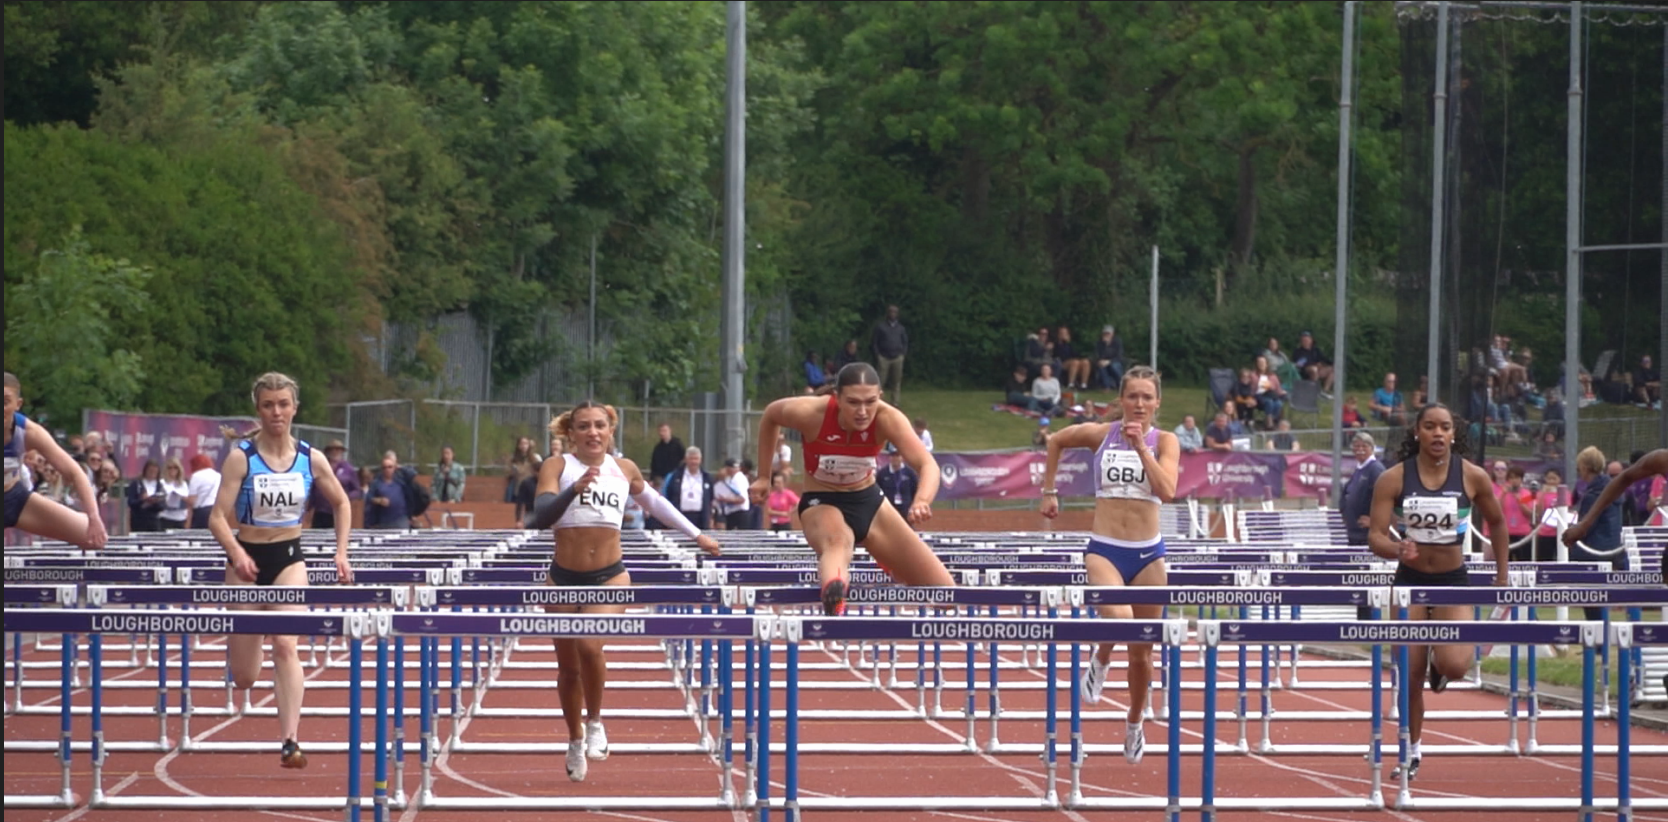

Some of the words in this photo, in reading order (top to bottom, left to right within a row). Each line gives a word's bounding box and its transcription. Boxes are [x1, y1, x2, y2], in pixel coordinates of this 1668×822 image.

[1107, 466, 1145, 483] GBJ
[260, 491, 298, 507] NAL
[580, 488, 619, 508] ENG
[1409, 513, 1453, 530] 224
[4, 570, 83, 580] UGHBOROUGH
[1342, 574, 1396, 585] LOUGHBO
[193, 589, 305, 602] LOUGHBOROUGH
[522, 591, 635, 603] LOUGHBOROUGH
[849, 589, 954, 602] OUGHBOROUGH
[1170, 591, 1282, 603] LOUGHBOROUGH
[1497, 590, 1608, 603] LOUGHBOROUGH
[92, 615, 234, 632] LOUGHBOROUGH
[501, 618, 645, 633] LOUGHBOROUGH
[912, 622, 1054, 639] LOUGHBOROUGH
[1340, 626, 1460, 639] LOUGHBOROUGH
